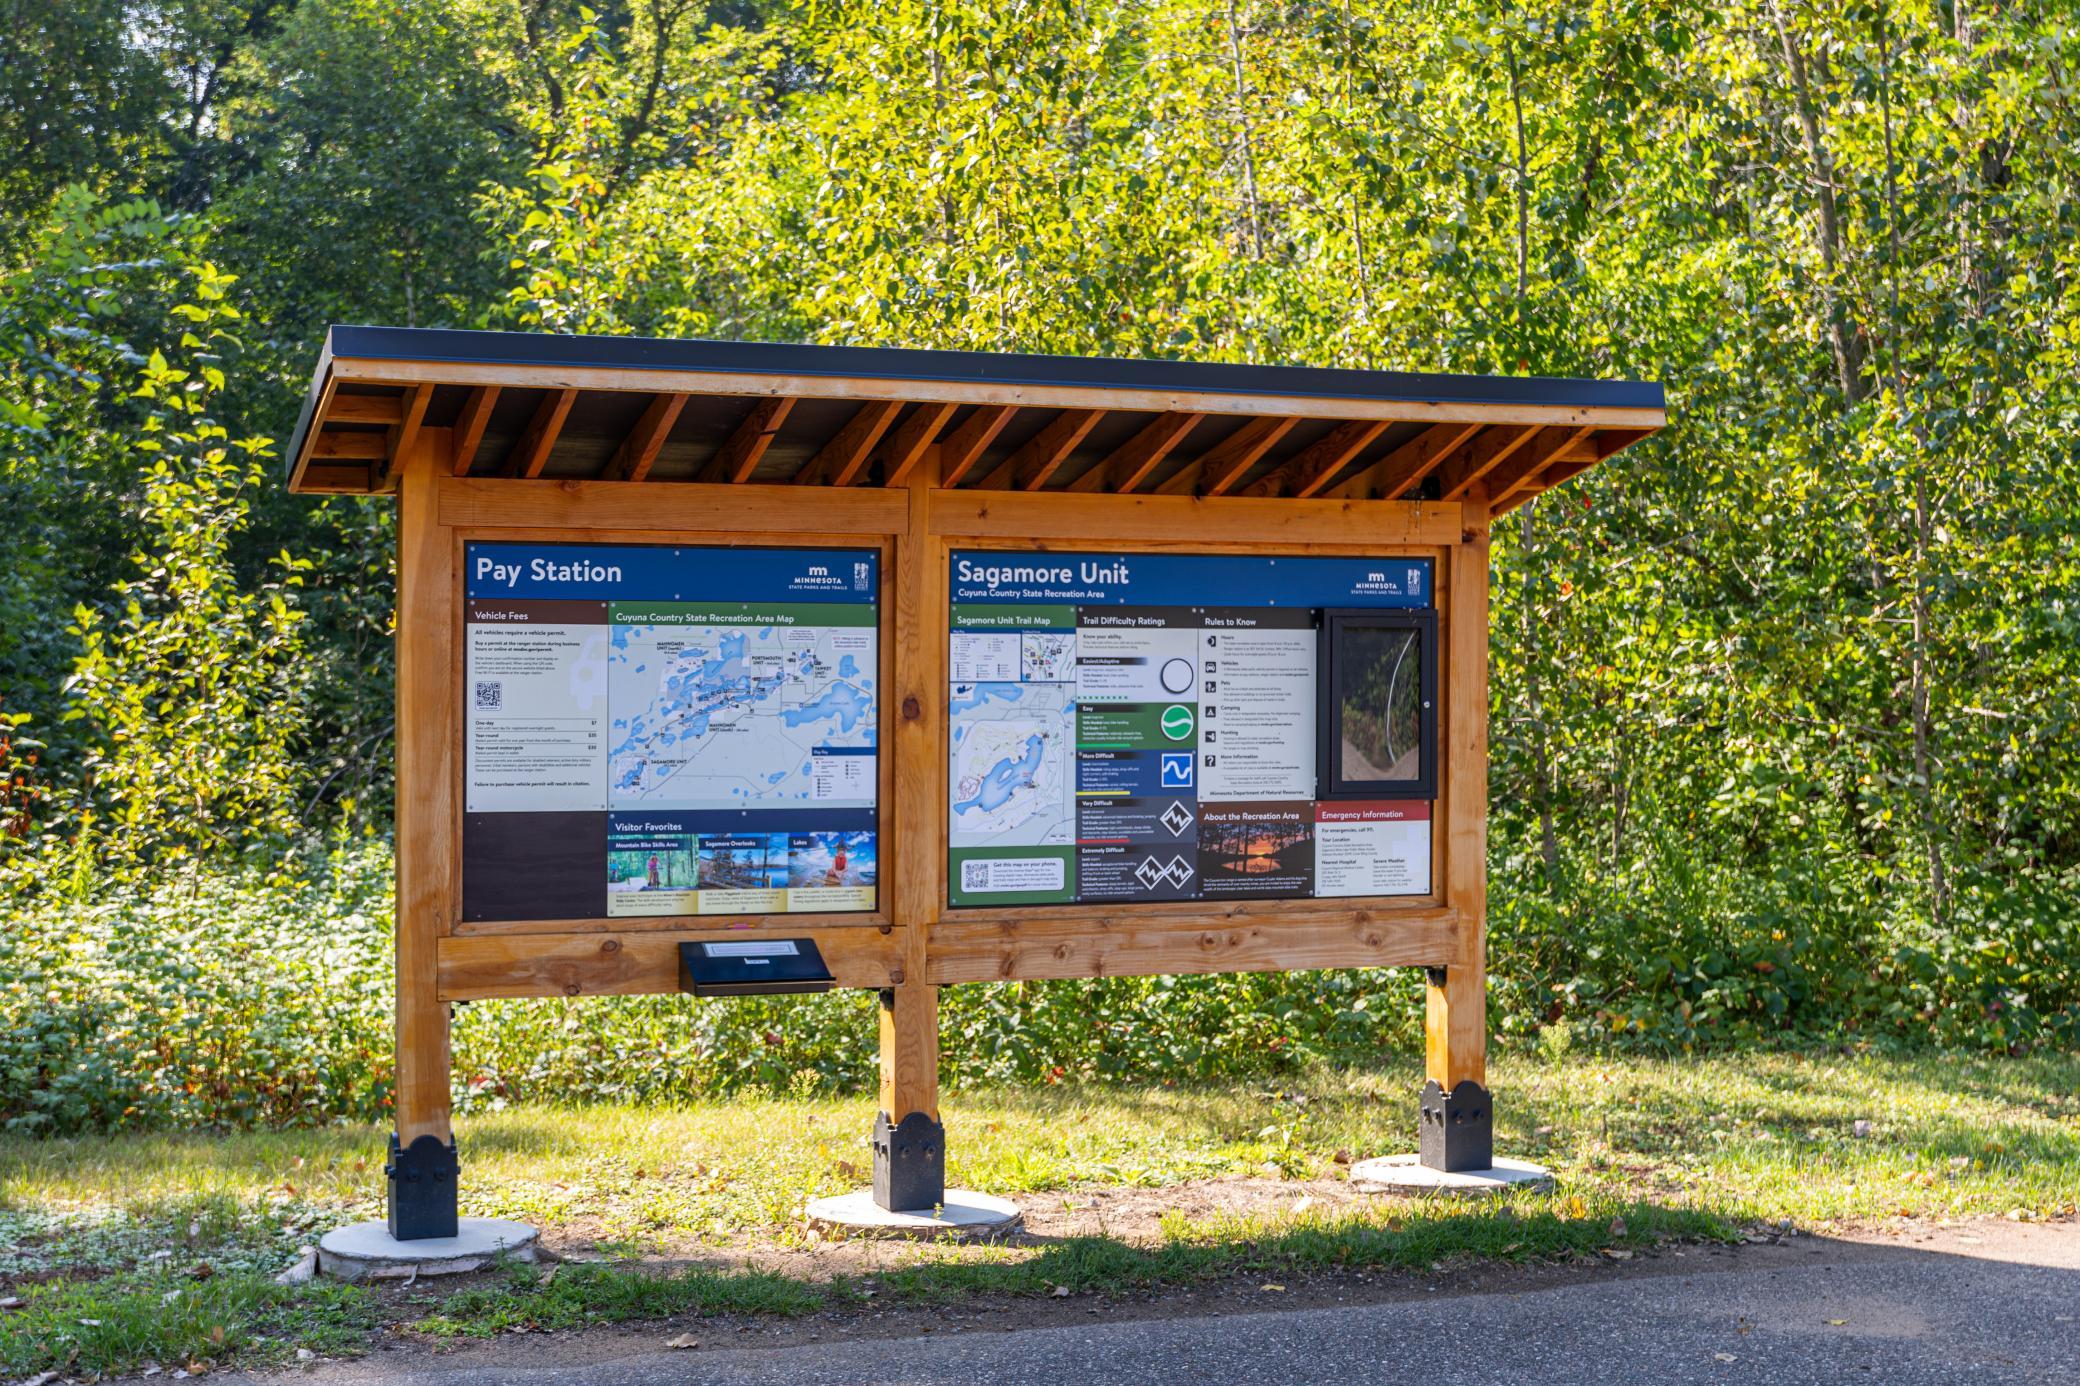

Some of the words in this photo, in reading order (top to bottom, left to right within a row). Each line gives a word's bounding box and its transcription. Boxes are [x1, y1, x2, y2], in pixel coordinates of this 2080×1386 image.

[477, 558, 522, 587] Pay
[531, 559, 621, 582] Station
[958, 560, 1072, 588] Sagamore
[1081, 562, 1130, 584] Unit
[959, 589, 987, 597] Cuyuna
[990, 589, 1021, 599] Country
[1045, 590, 1085, 598] Recreation
[475, 612, 506, 620] Vehicle
[509, 612, 528, 620] Fees
[616, 613, 647, 623] Cuyuna
[650, 614, 683, 624] Country
[686, 614, 707, 622] State
[709, 614, 753, 622] Recreation
[755, 615, 775, 623] Area
[777, 615, 794, 624] Map
[957, 616, 995, 626] Sagamore
[998, 616, 1014, 625] Unit
[1015, 616, 1032, 625] Trail
[1034, 616, 1050, 626] Map
[1101, 617, 1136, 626] Difficulty
[1138, 617, 1165, 627] Ratings
[1242, 812, 1280, 820] Recreation
[1322, 811, 1361, 820] Emergency
[1363, 810, 1403, 818] Information
[615, 823, 643, 831] Visitor
[645, 823, 682, 831] Favorites
